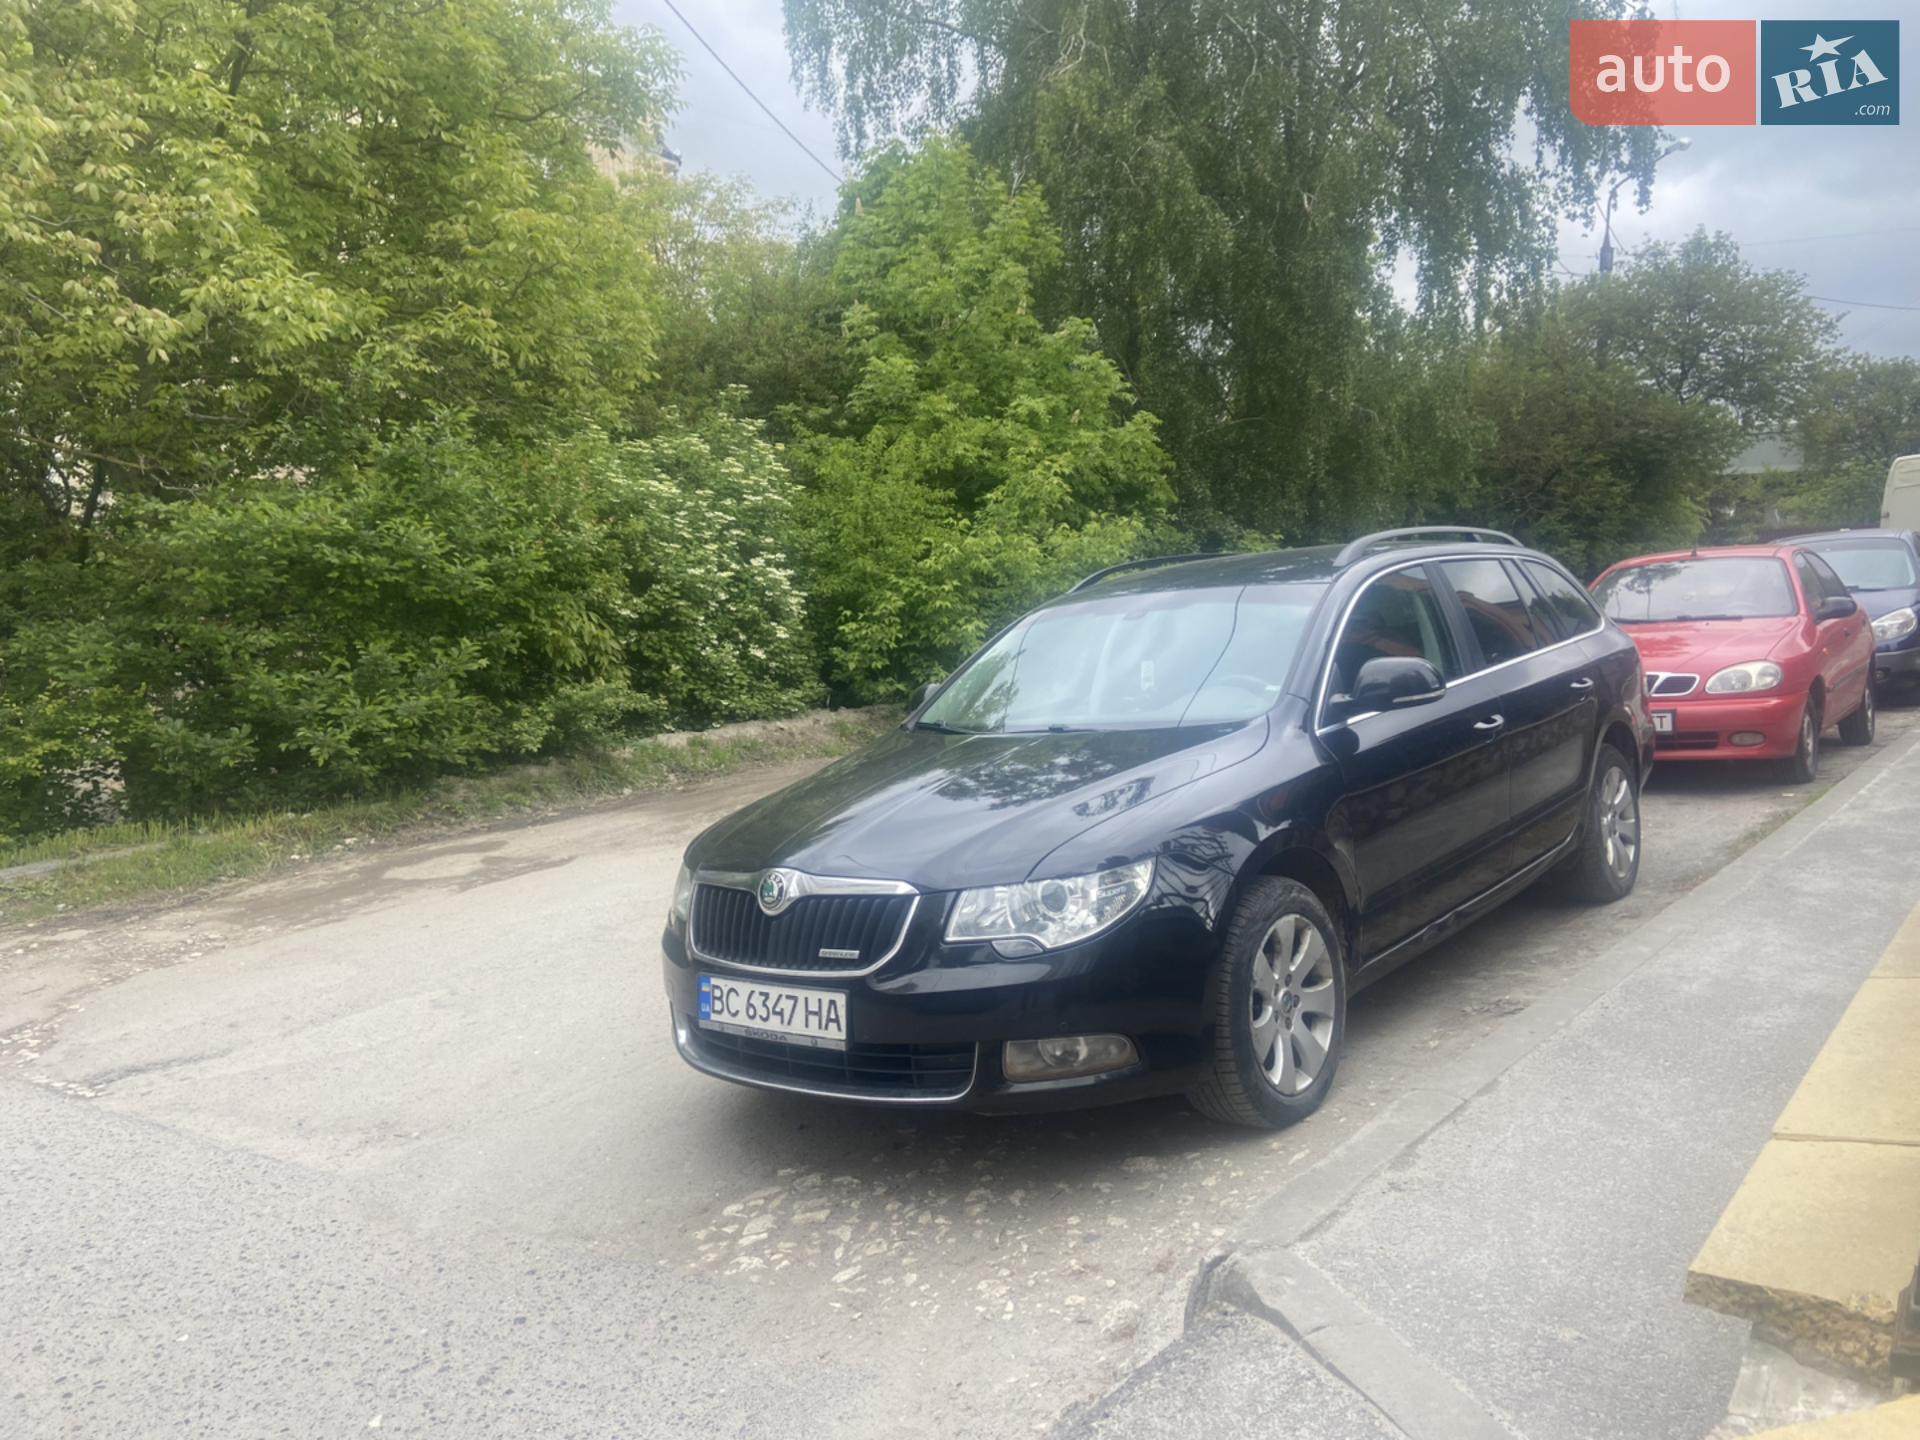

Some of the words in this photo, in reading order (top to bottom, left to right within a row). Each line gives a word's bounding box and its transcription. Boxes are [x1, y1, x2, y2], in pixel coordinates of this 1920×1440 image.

[700, 1002, 710, 1012] UA
[711, 983, 740, 1018] BC
[745, 990, 799, 1027] 6347
[804, 996, 842, 1032] HA
